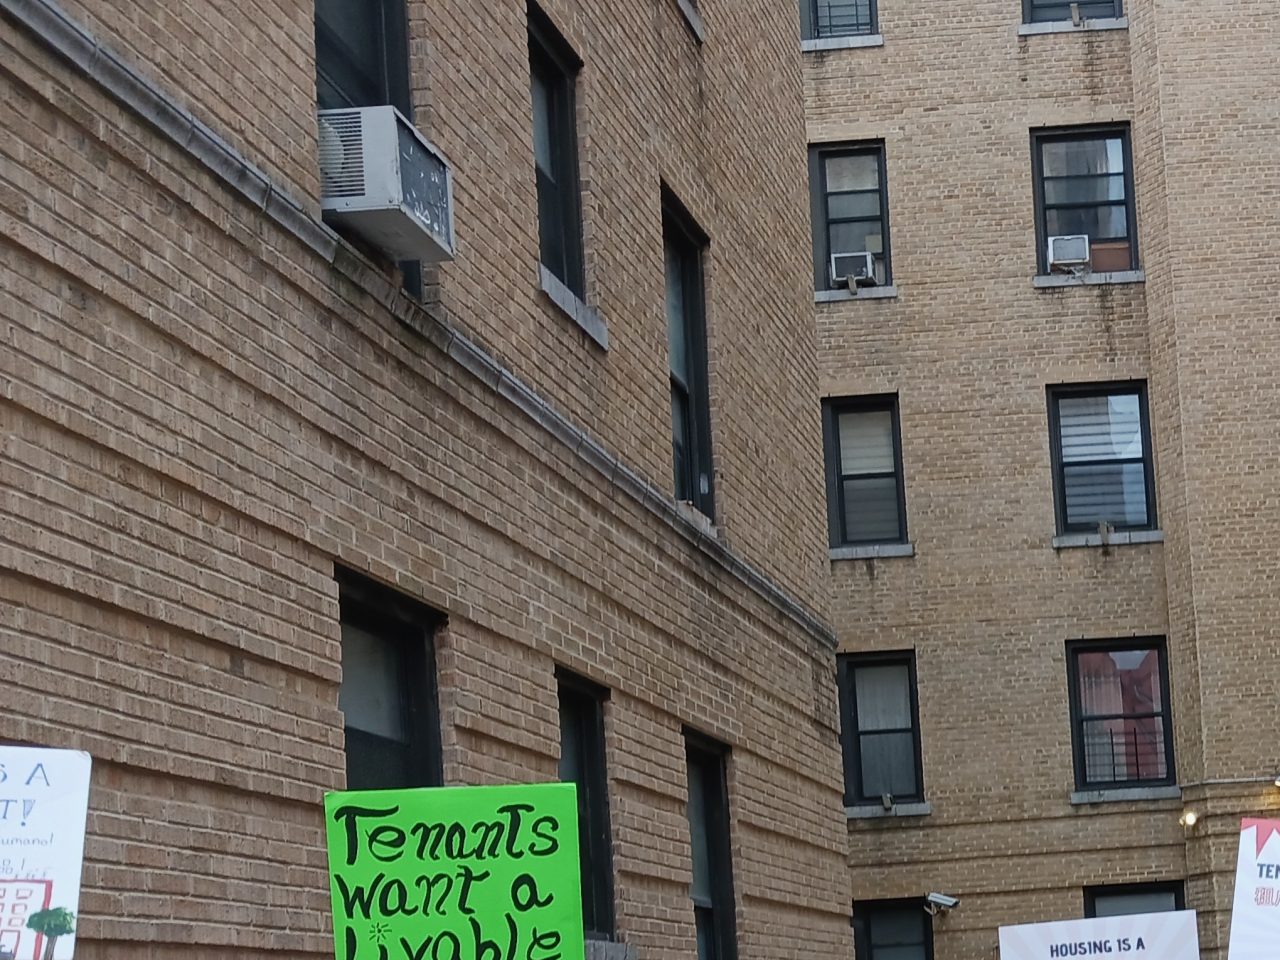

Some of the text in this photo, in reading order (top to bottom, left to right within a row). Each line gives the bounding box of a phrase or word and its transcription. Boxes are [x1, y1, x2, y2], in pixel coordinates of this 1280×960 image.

[334, 804, 560, 866] Tenants
[334, 865, 554, 919] want a
[1050, 937, 1146, 958] HOUSING IS A
